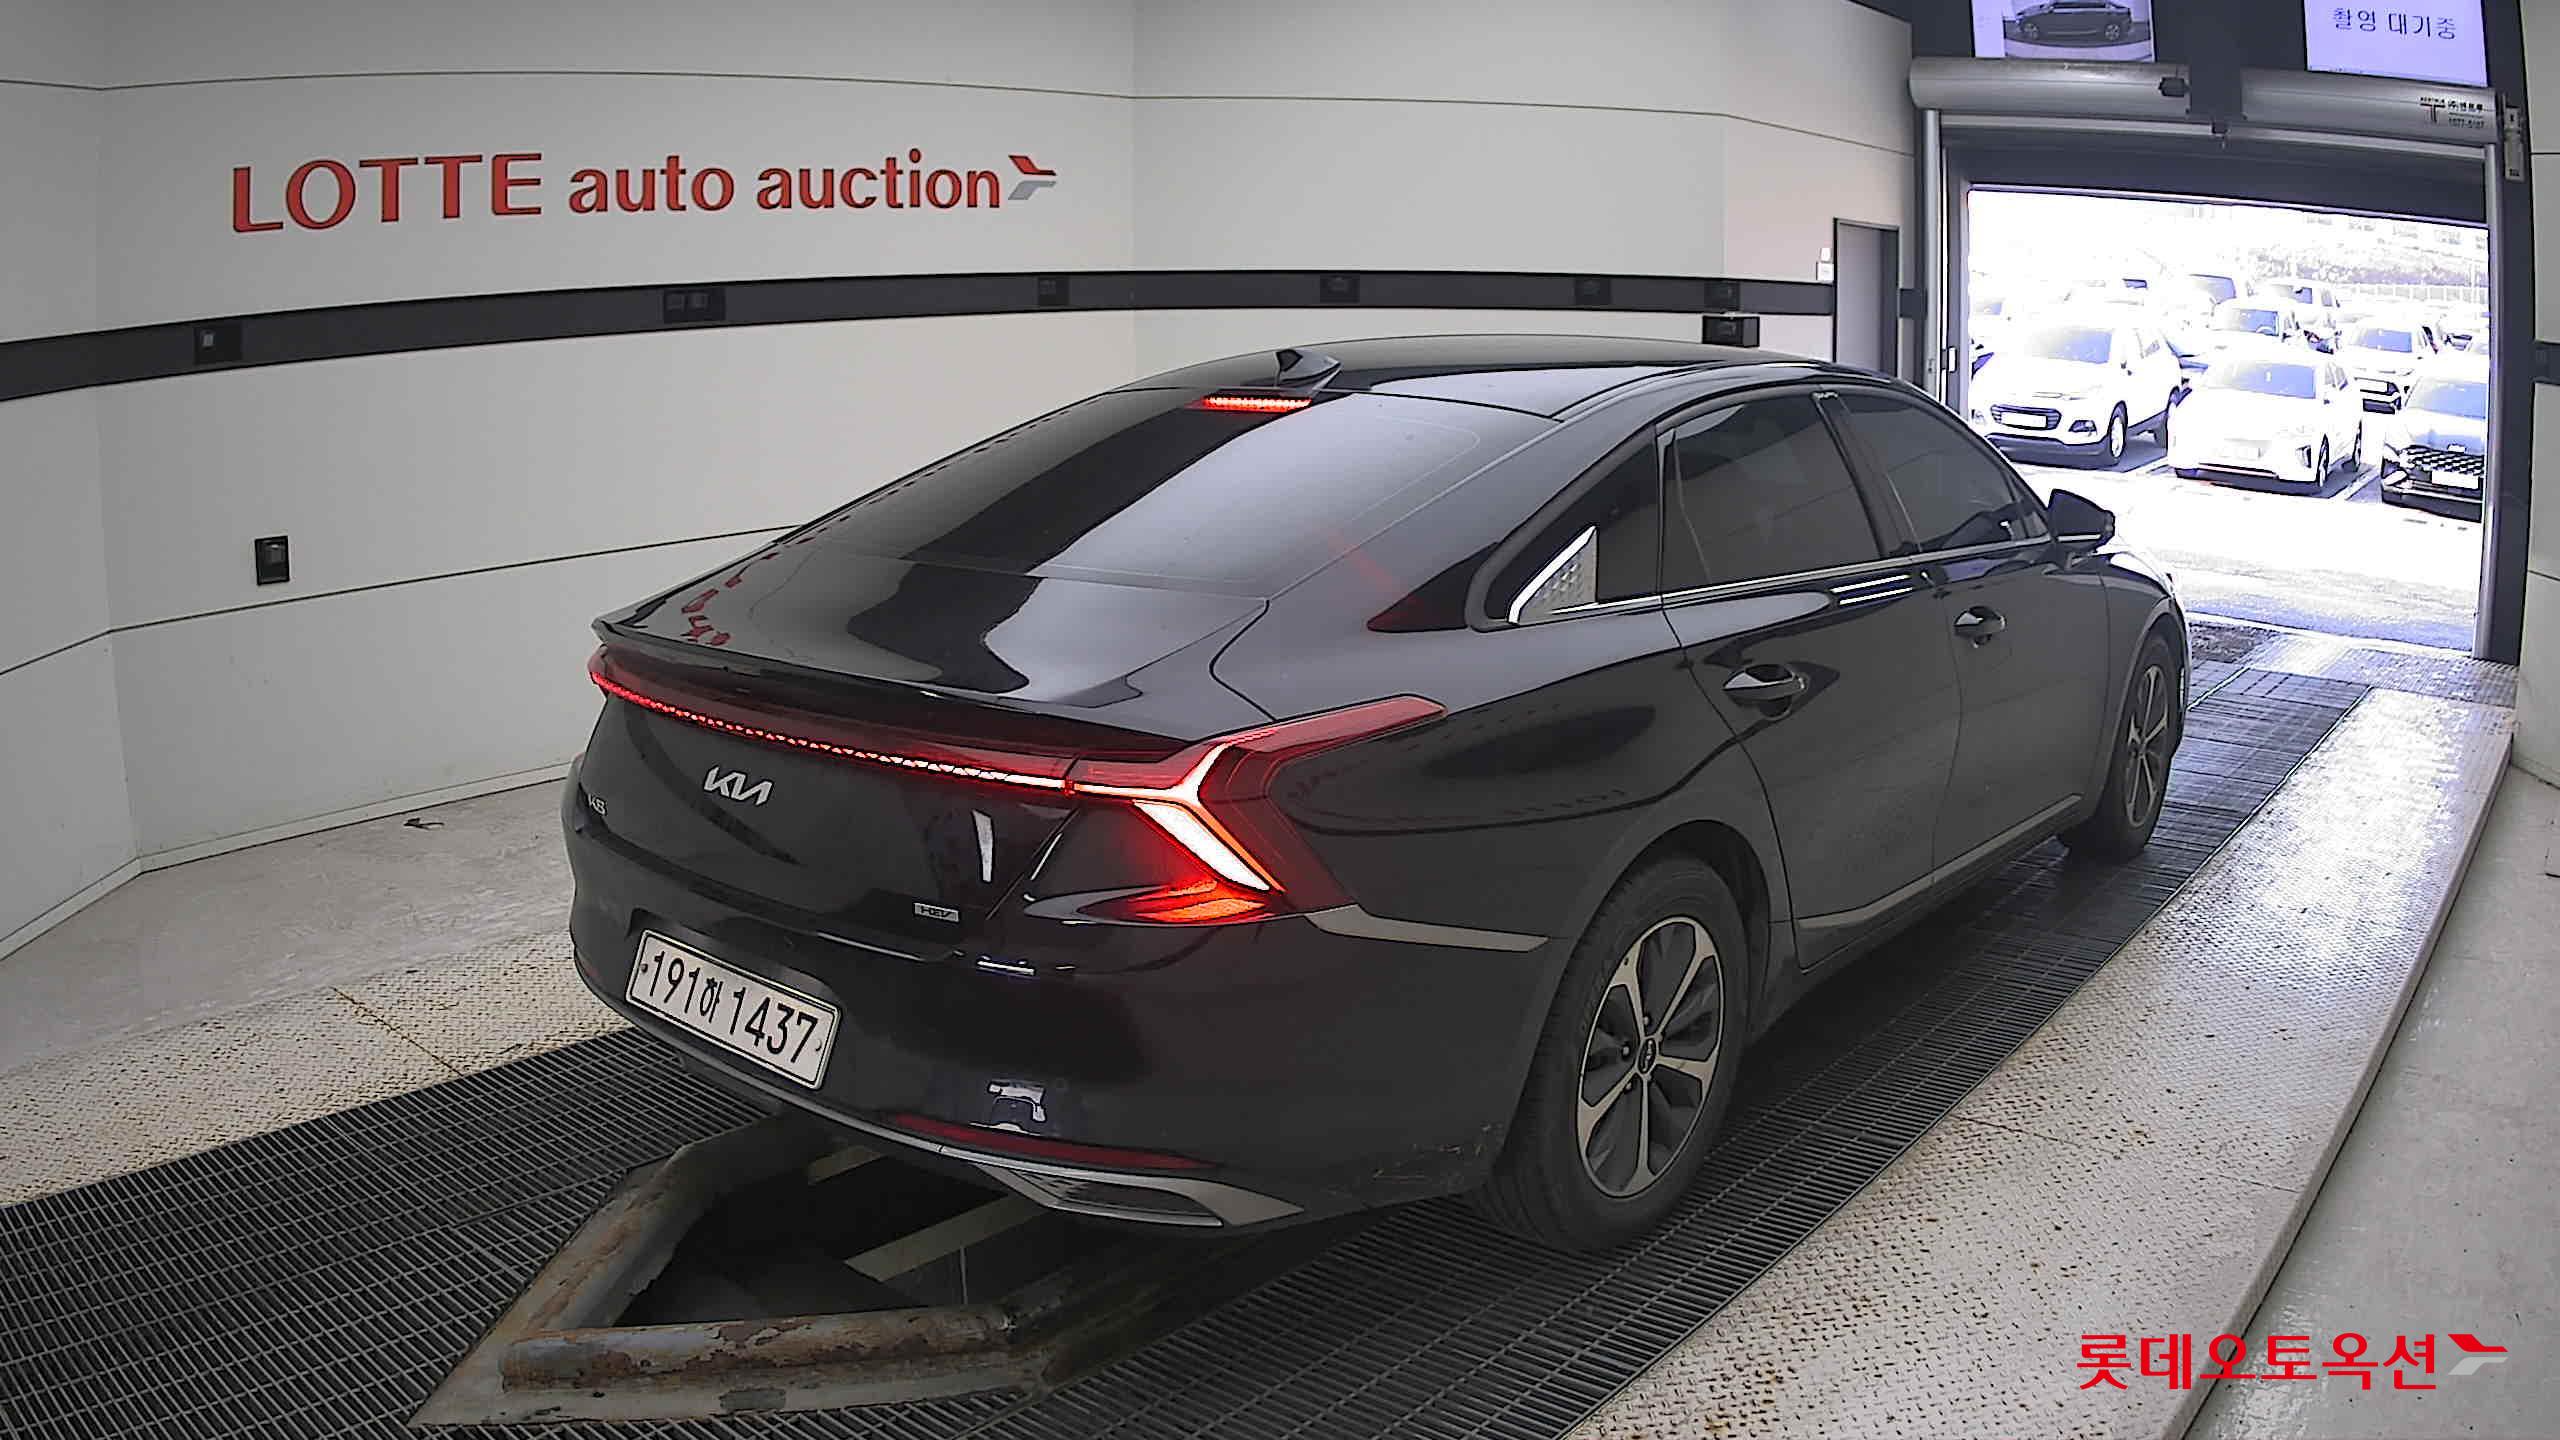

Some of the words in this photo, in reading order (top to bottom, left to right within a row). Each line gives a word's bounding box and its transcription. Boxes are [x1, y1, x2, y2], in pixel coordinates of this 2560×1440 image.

[2333, 8, 2376, 33] 촬영
[2388, 13, 2456, 40] 대기중
[233, 152, 543, 233] LOTTE
[568, 154, 736, 214] auto
[756, 147, 1001, 210] auction
[703, 766, 773, 806] KIA
[649, 950, 723, 1024] 191하
[729, 986, 819, 1064] 1437
